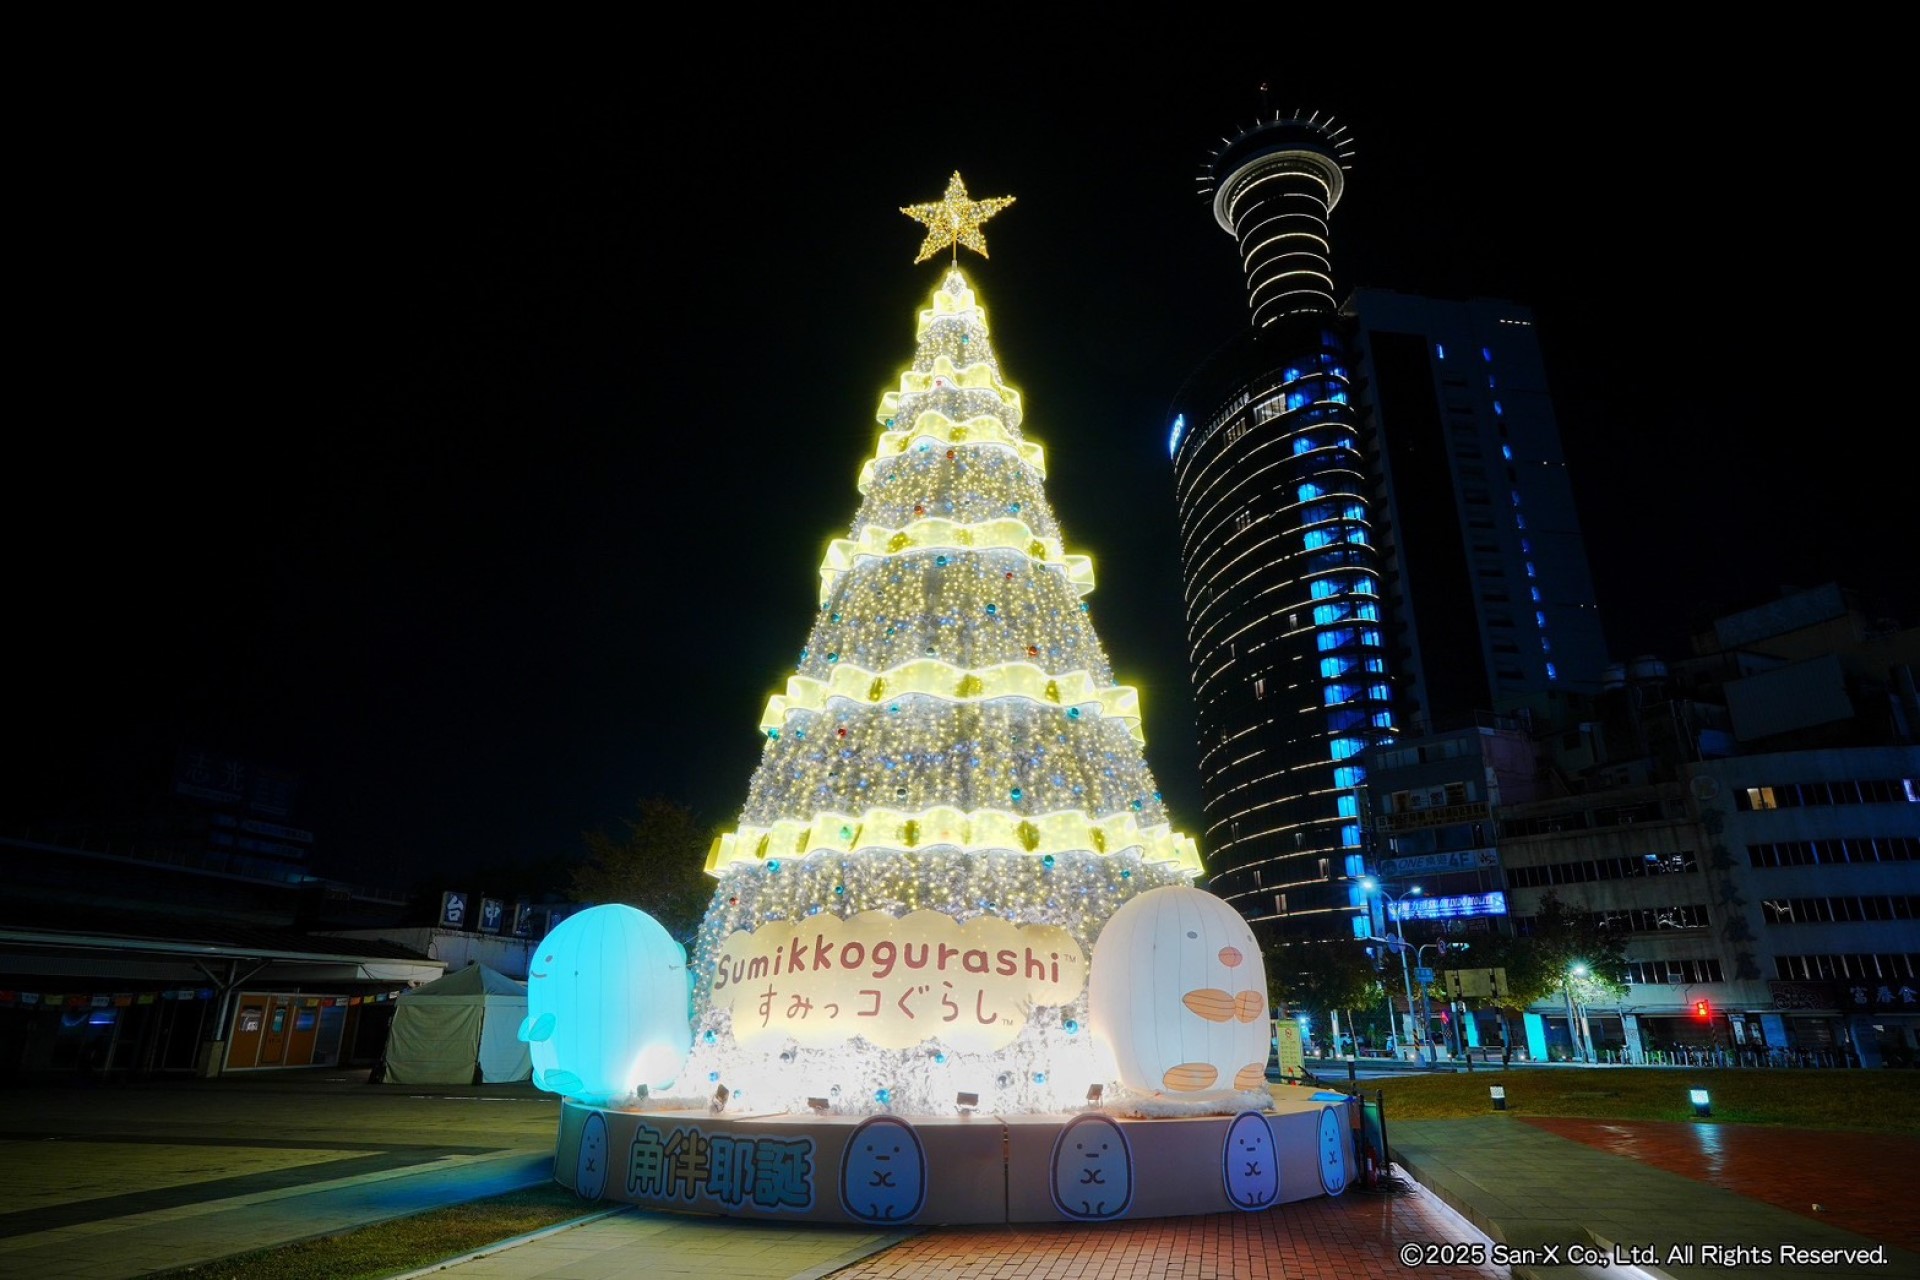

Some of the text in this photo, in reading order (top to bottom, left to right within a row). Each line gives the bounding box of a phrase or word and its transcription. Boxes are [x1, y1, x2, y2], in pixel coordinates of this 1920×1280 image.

[714, 934, 1061, 990] Sumikkogurashi
[759, 981, 997, 1027] すみっコぐらし
[628, 1126, 813, 1209] 角伴耶誕
